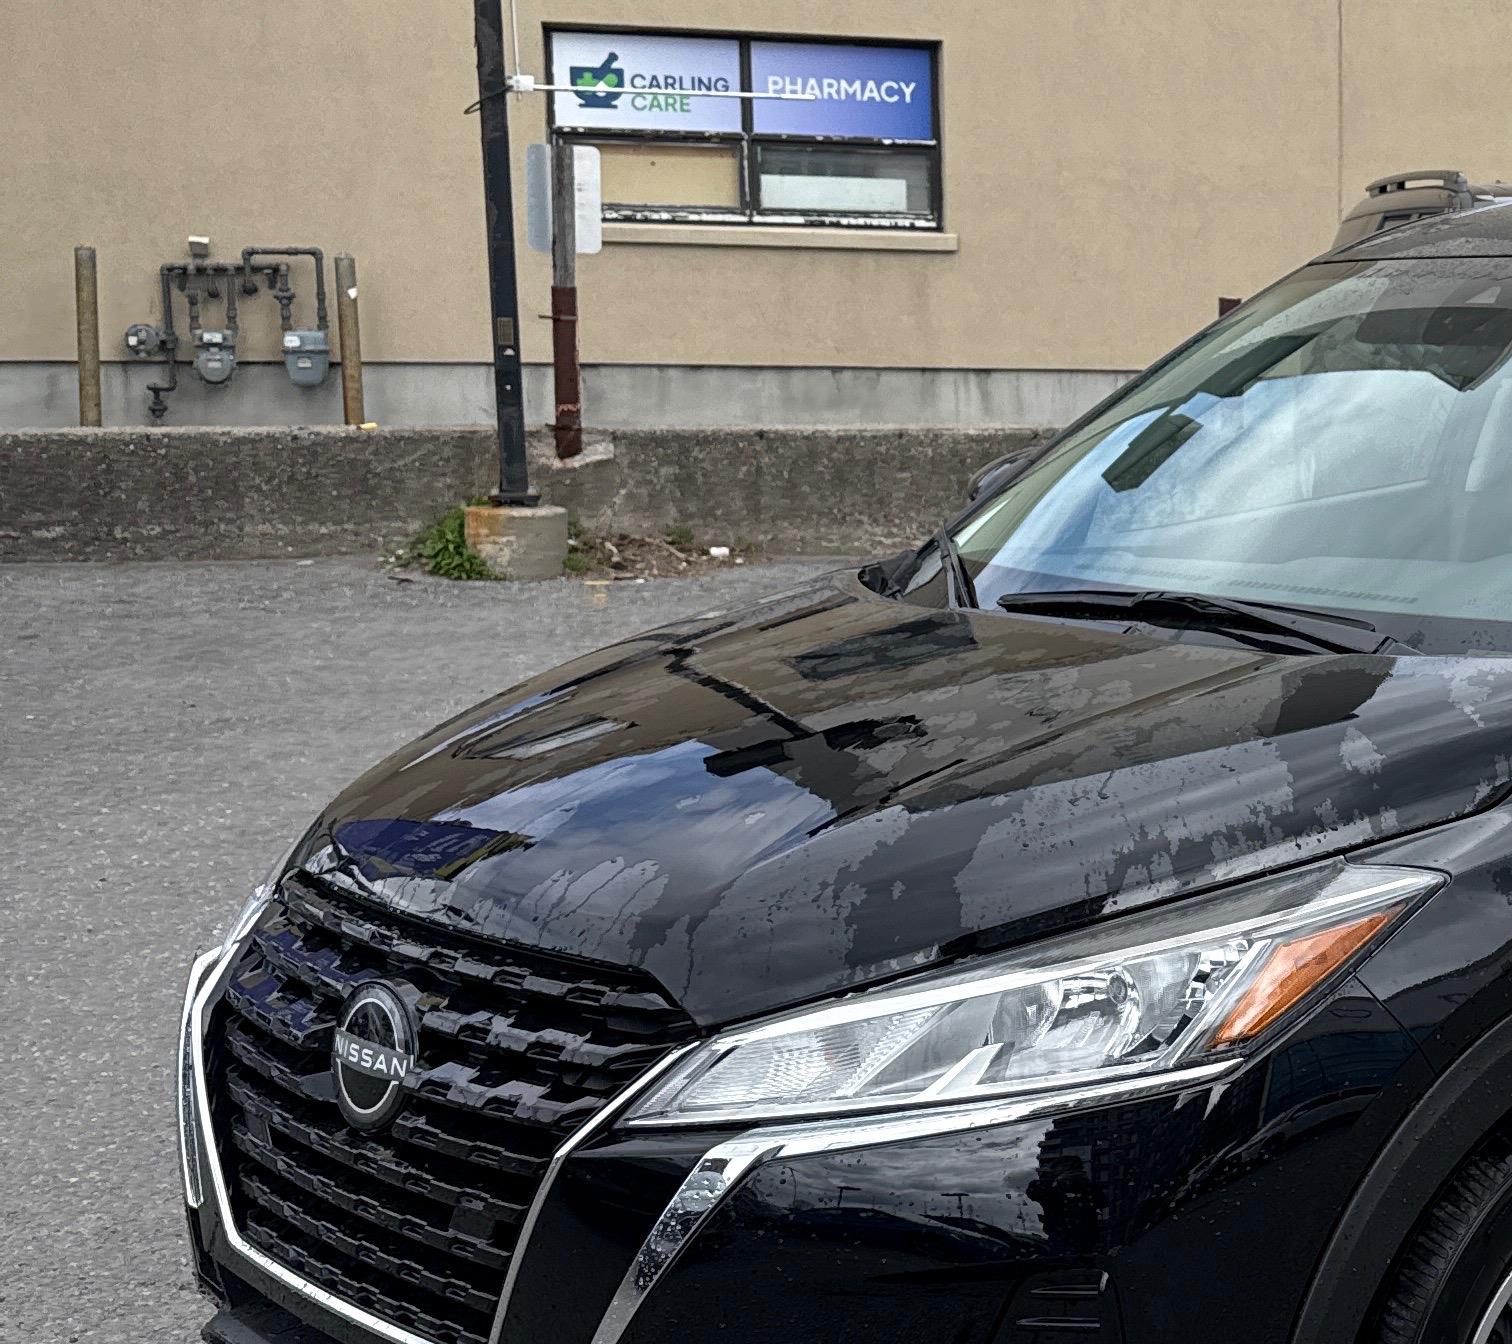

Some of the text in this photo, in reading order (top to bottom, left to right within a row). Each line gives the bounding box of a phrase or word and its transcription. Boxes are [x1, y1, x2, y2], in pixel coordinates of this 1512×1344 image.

[630, 73, 730, 92] CARLING
[767, 75, 916, 103] PHARMACY
[631, 94, 691, 112] CARE
[334, 1033, 408, 1078] NISSAN
